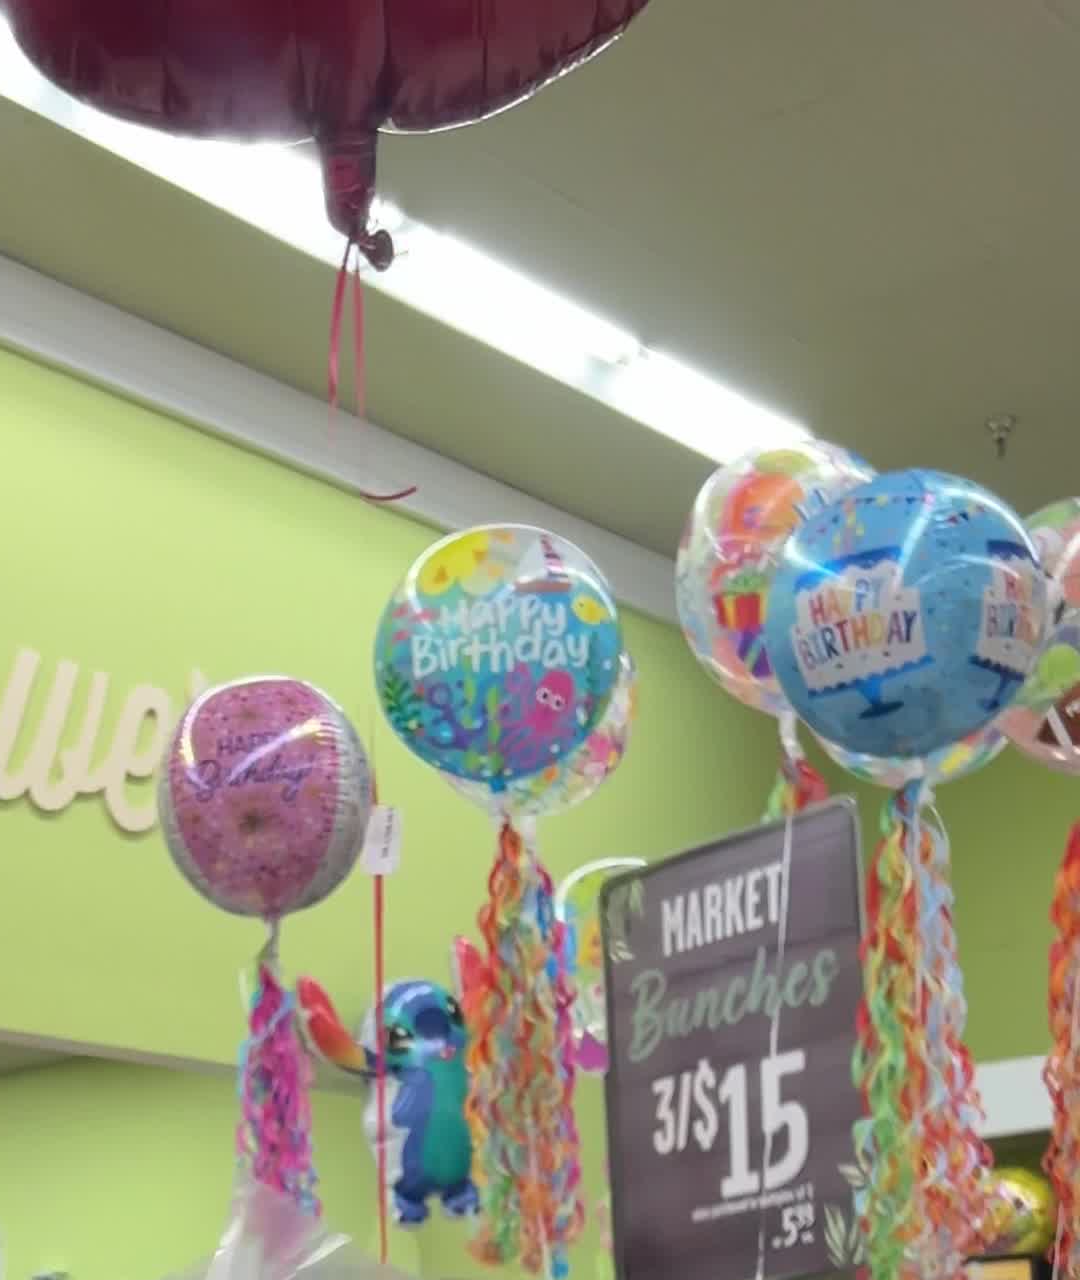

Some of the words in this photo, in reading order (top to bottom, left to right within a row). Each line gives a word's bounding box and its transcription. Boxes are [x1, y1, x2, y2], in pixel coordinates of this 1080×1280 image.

[410, 621, 591, 678] Birthday
[796, 610, 918, 671] BIRTHDAY
[660, 862, 783, 957] MARKET
[629, 946, 838, 1062] Bunches
